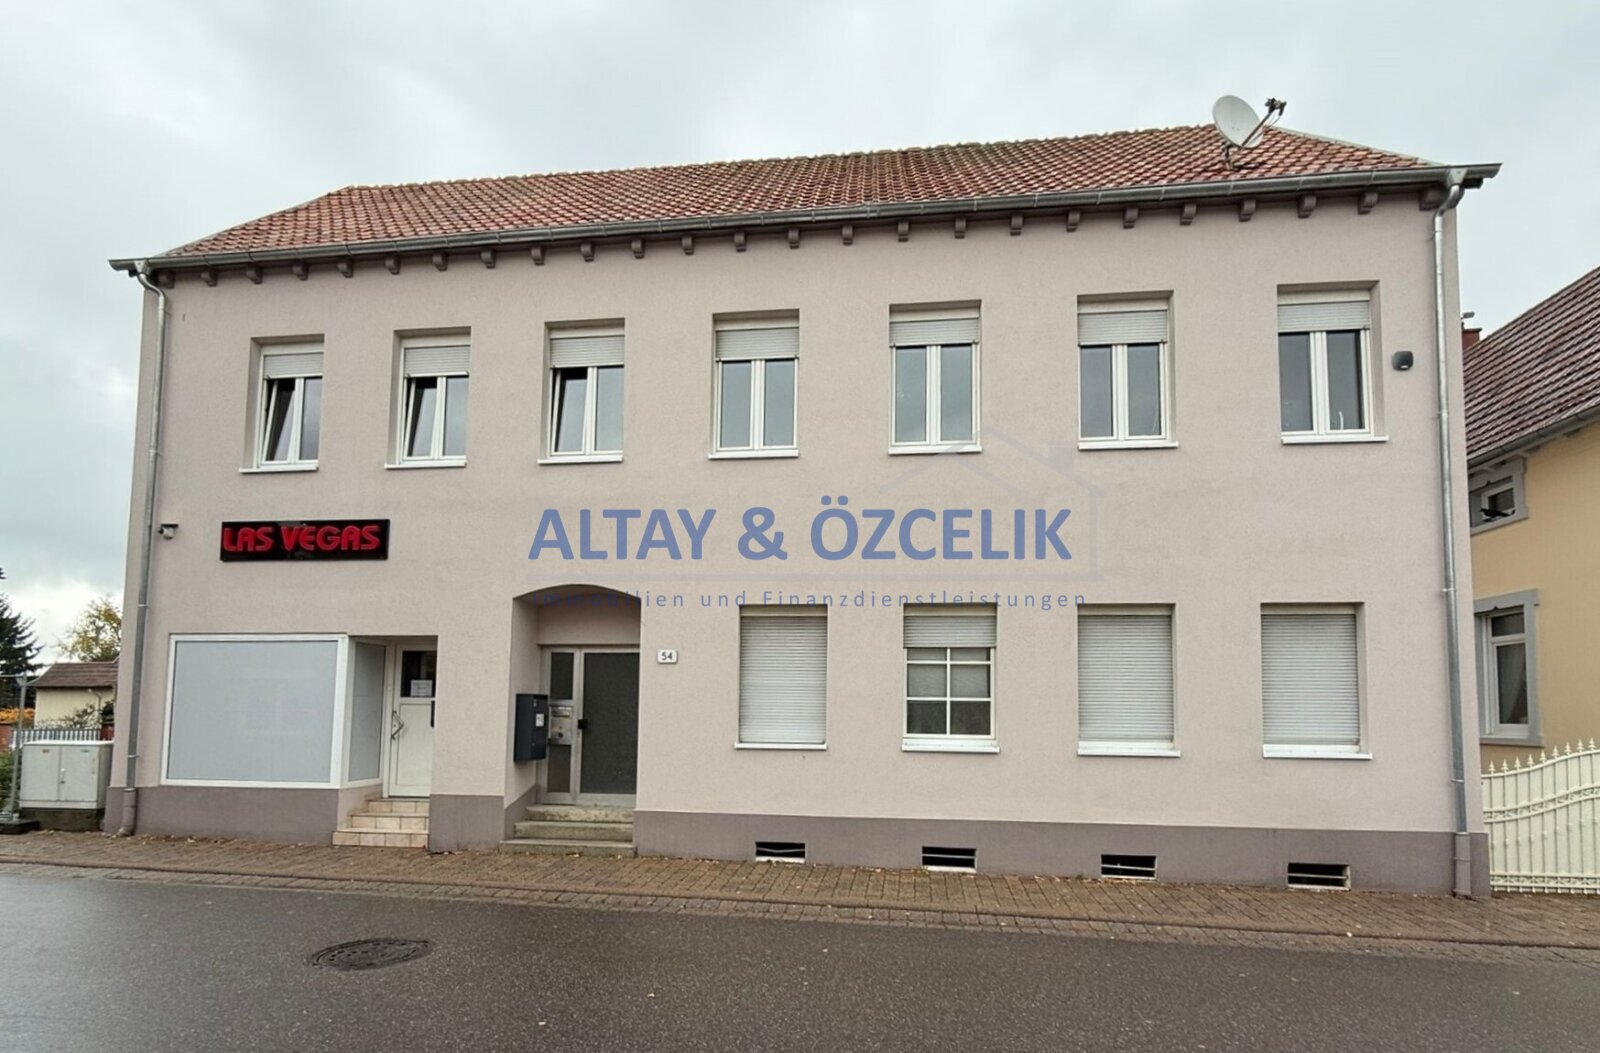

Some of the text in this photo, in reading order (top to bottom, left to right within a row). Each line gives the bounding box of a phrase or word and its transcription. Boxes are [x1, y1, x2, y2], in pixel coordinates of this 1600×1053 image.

[222, 525, 381, 552] LAS VEGAS
[661, 651, 673, 661] 54
